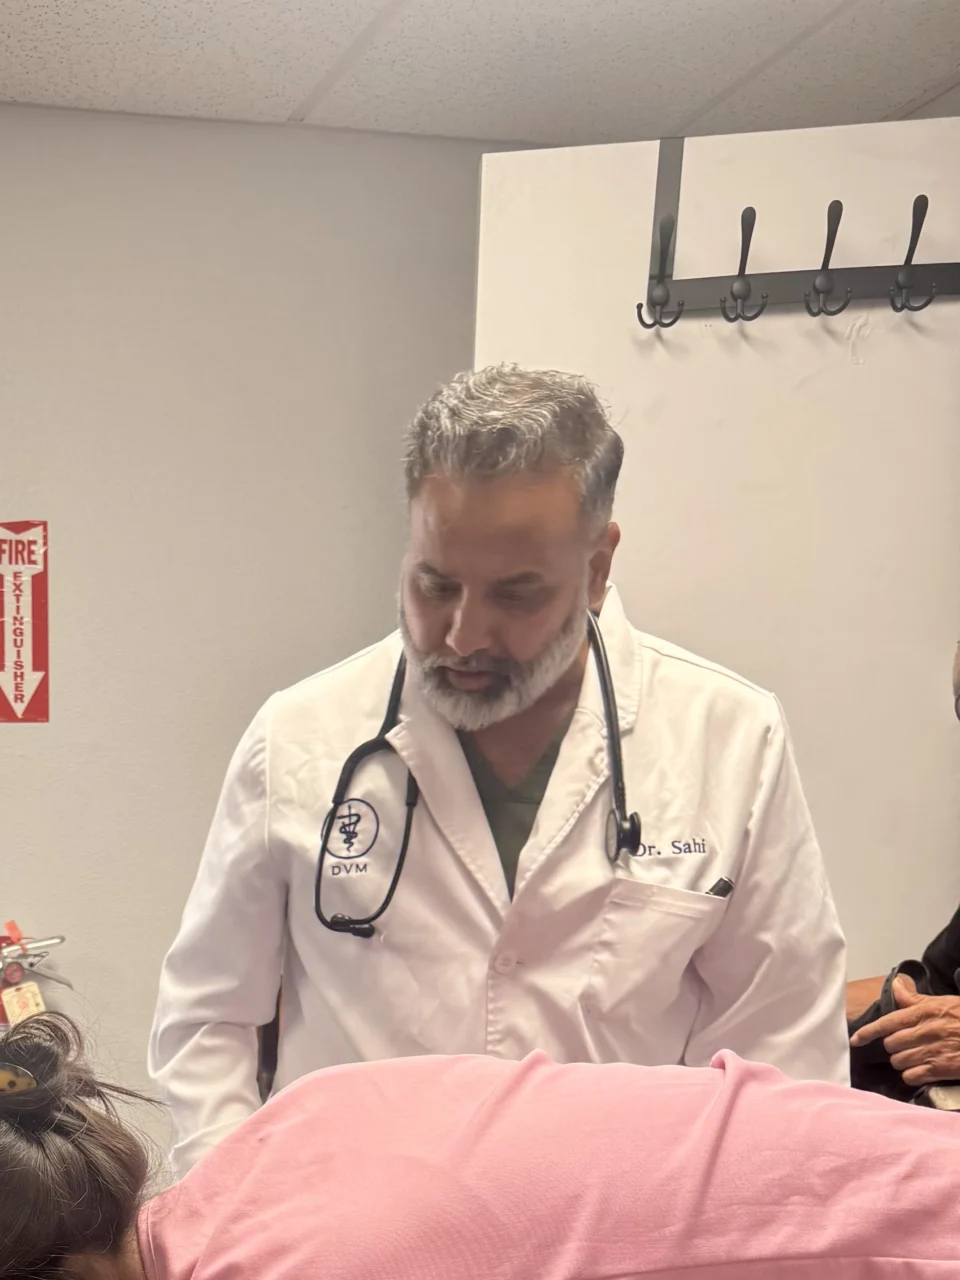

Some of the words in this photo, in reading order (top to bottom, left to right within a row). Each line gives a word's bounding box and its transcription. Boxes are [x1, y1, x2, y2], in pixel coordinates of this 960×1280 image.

[12, 571, 25, 704] EXTINGUISHER
[636, 843, 662, 857] Dr.
[670, 838, 707, 855] Sahi
[331, 863, 369, 876] DVM
